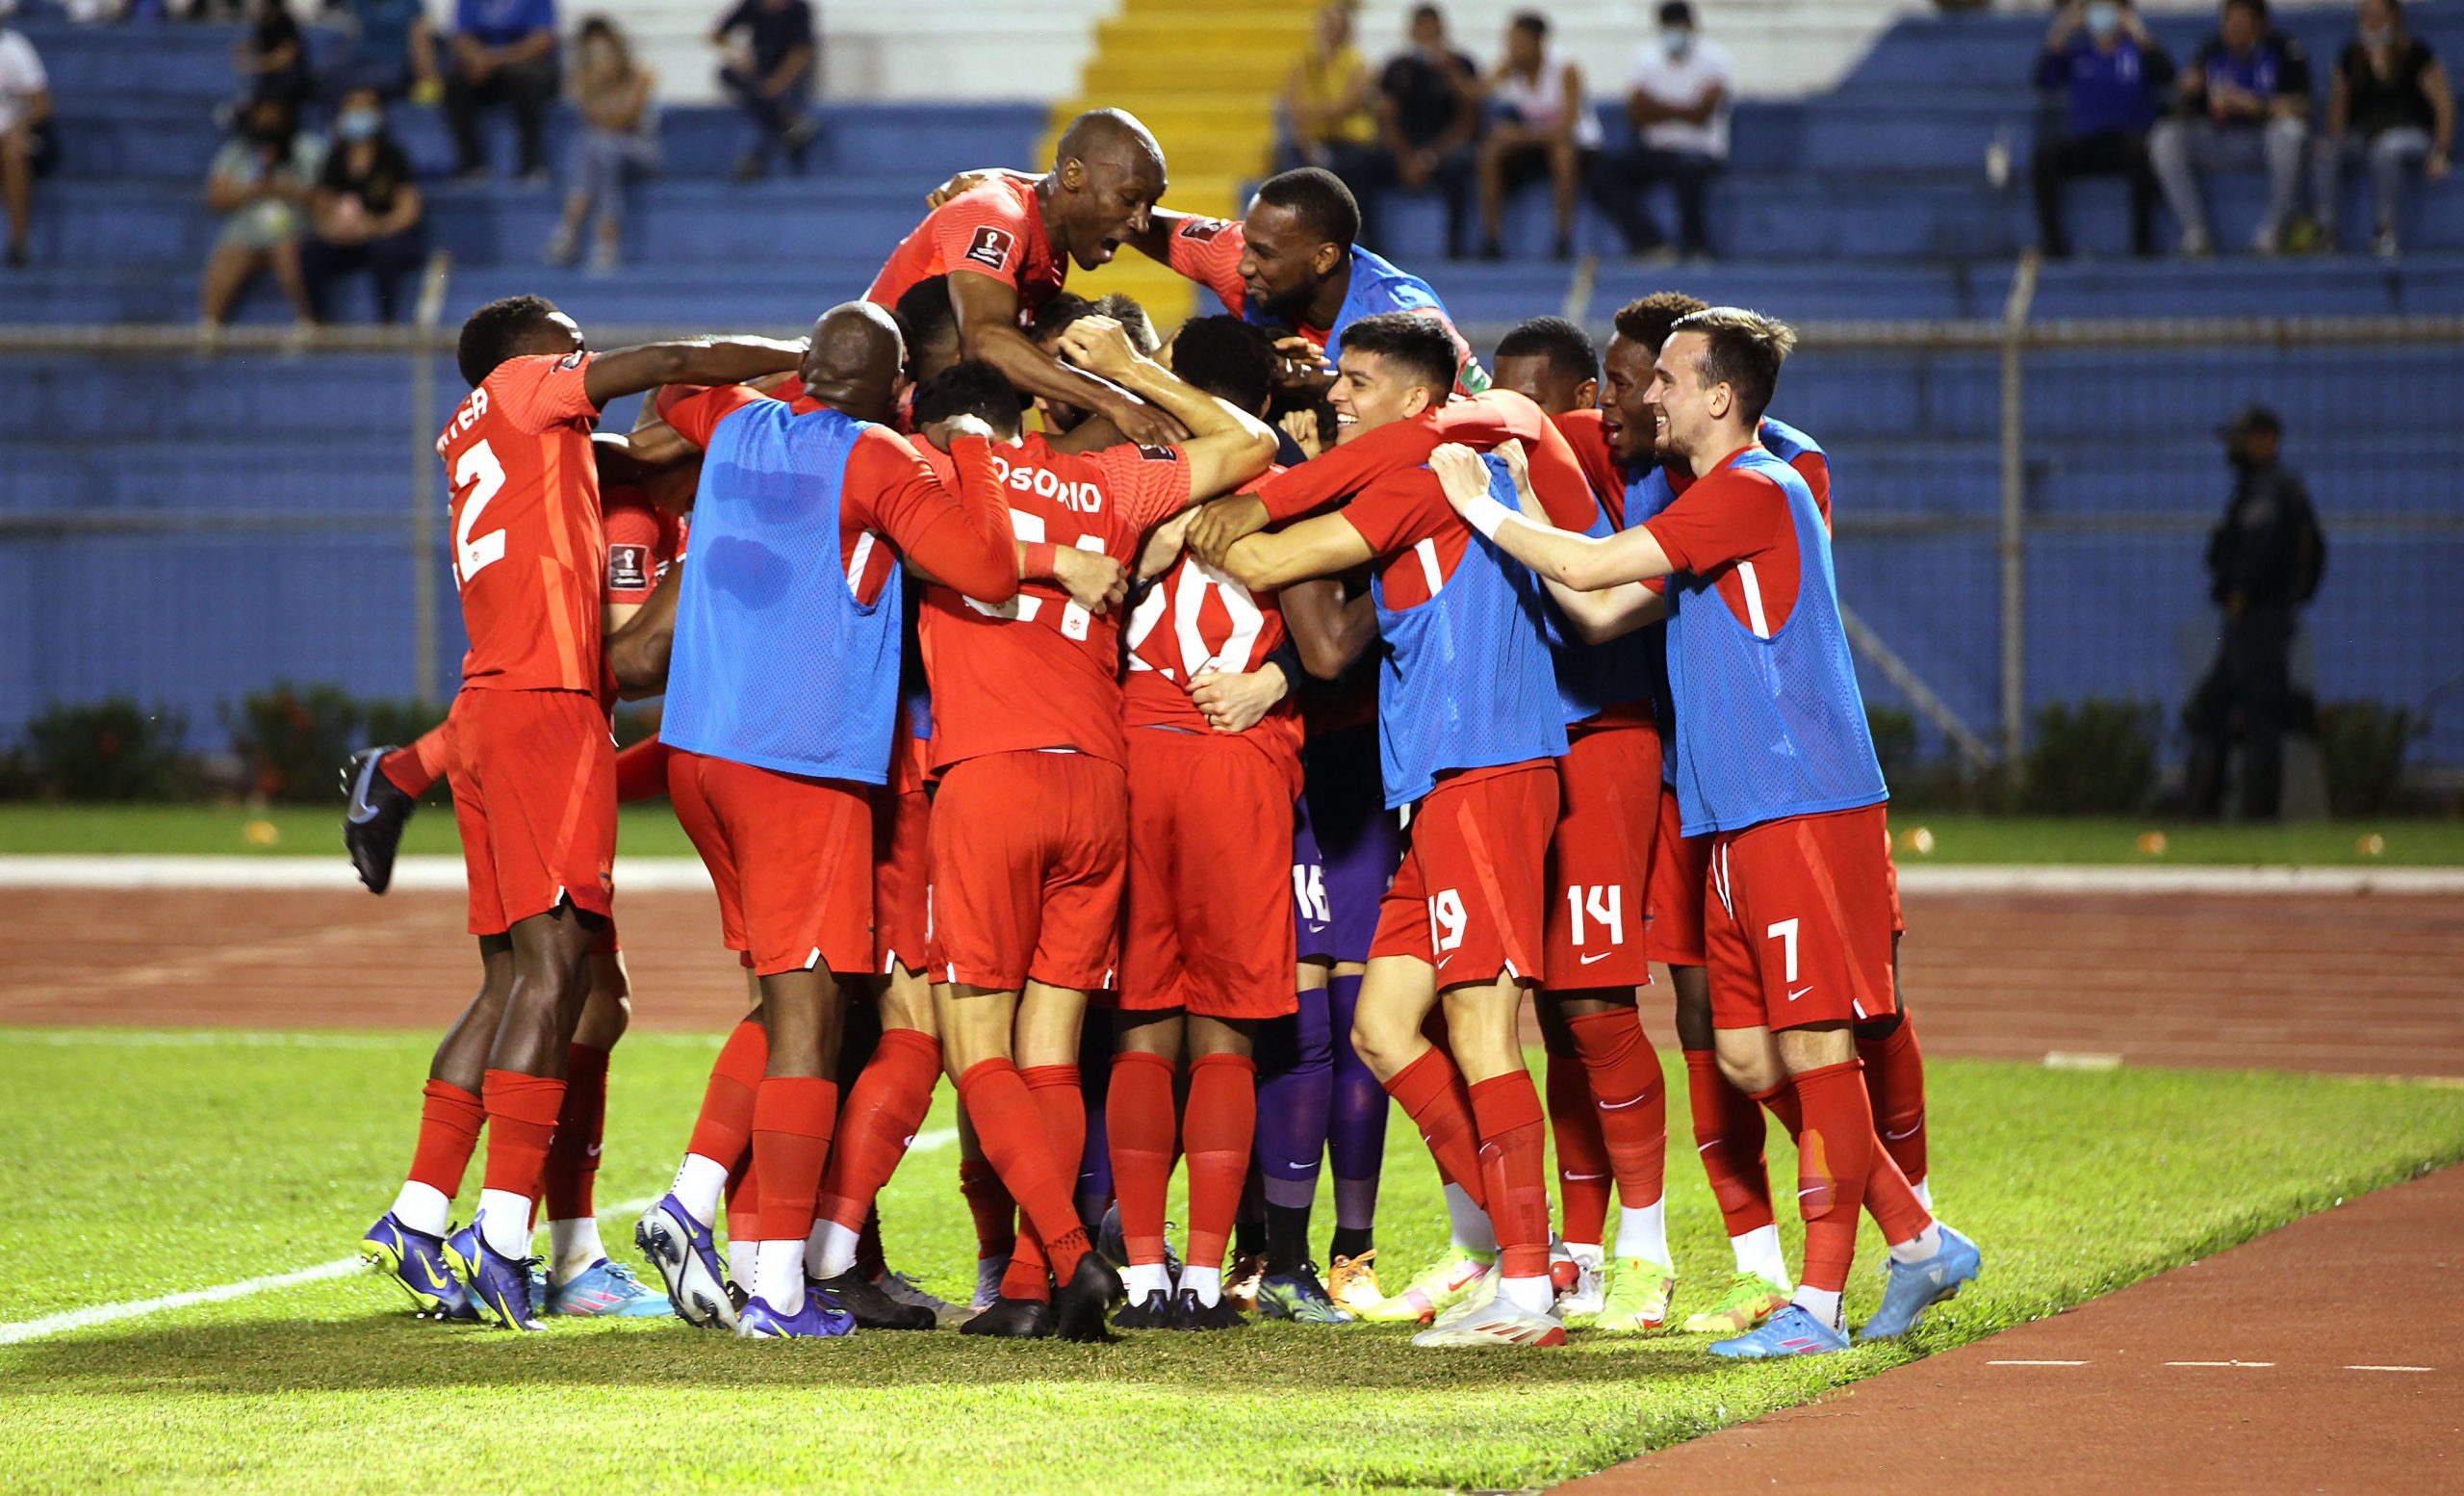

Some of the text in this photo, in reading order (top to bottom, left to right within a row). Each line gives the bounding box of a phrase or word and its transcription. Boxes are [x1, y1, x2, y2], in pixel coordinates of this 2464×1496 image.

[991, 455, 1102, 513] OSORIO
[1428, 888, 1468, 956] 19
[1567, 885, 1624, 945] 14
[1767, 917, 1799, 983] 7
